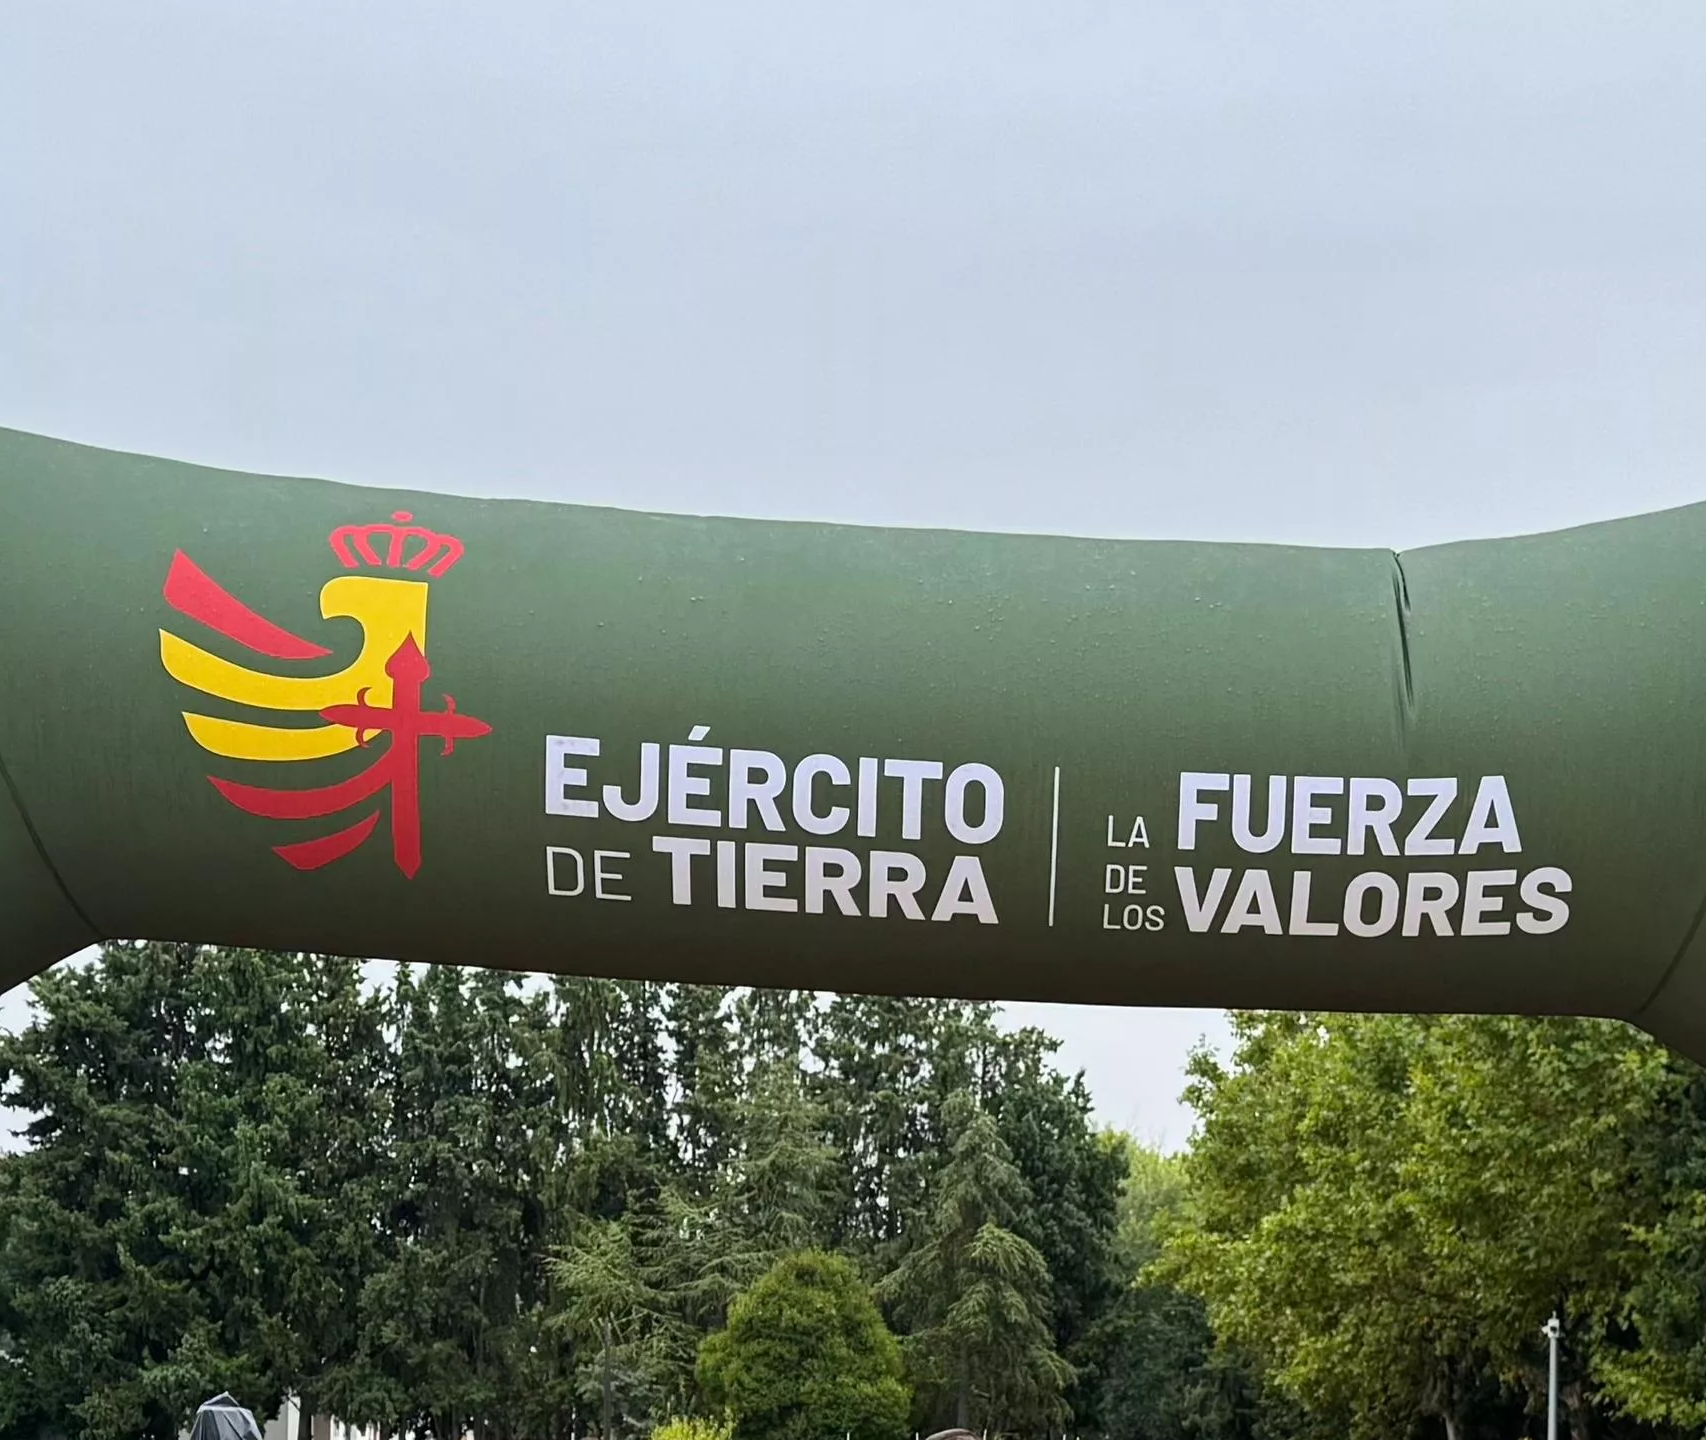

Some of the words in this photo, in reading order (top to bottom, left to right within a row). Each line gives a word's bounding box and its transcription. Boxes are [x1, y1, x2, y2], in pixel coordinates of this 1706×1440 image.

[545, 725, 1005, 845] EJÉRCITO
[1177, 771, 1523, 857] FUERZA
[1106, 814, 1151, 849] LA
[545, 845, 632, 902] DE
[651, 835, 1000, 924] TIERRA
[1104, 863, 1148, 896] DE
[1173, 866, 1573, 938] VALORES
[1102, 903, 1166, 932] LOS
